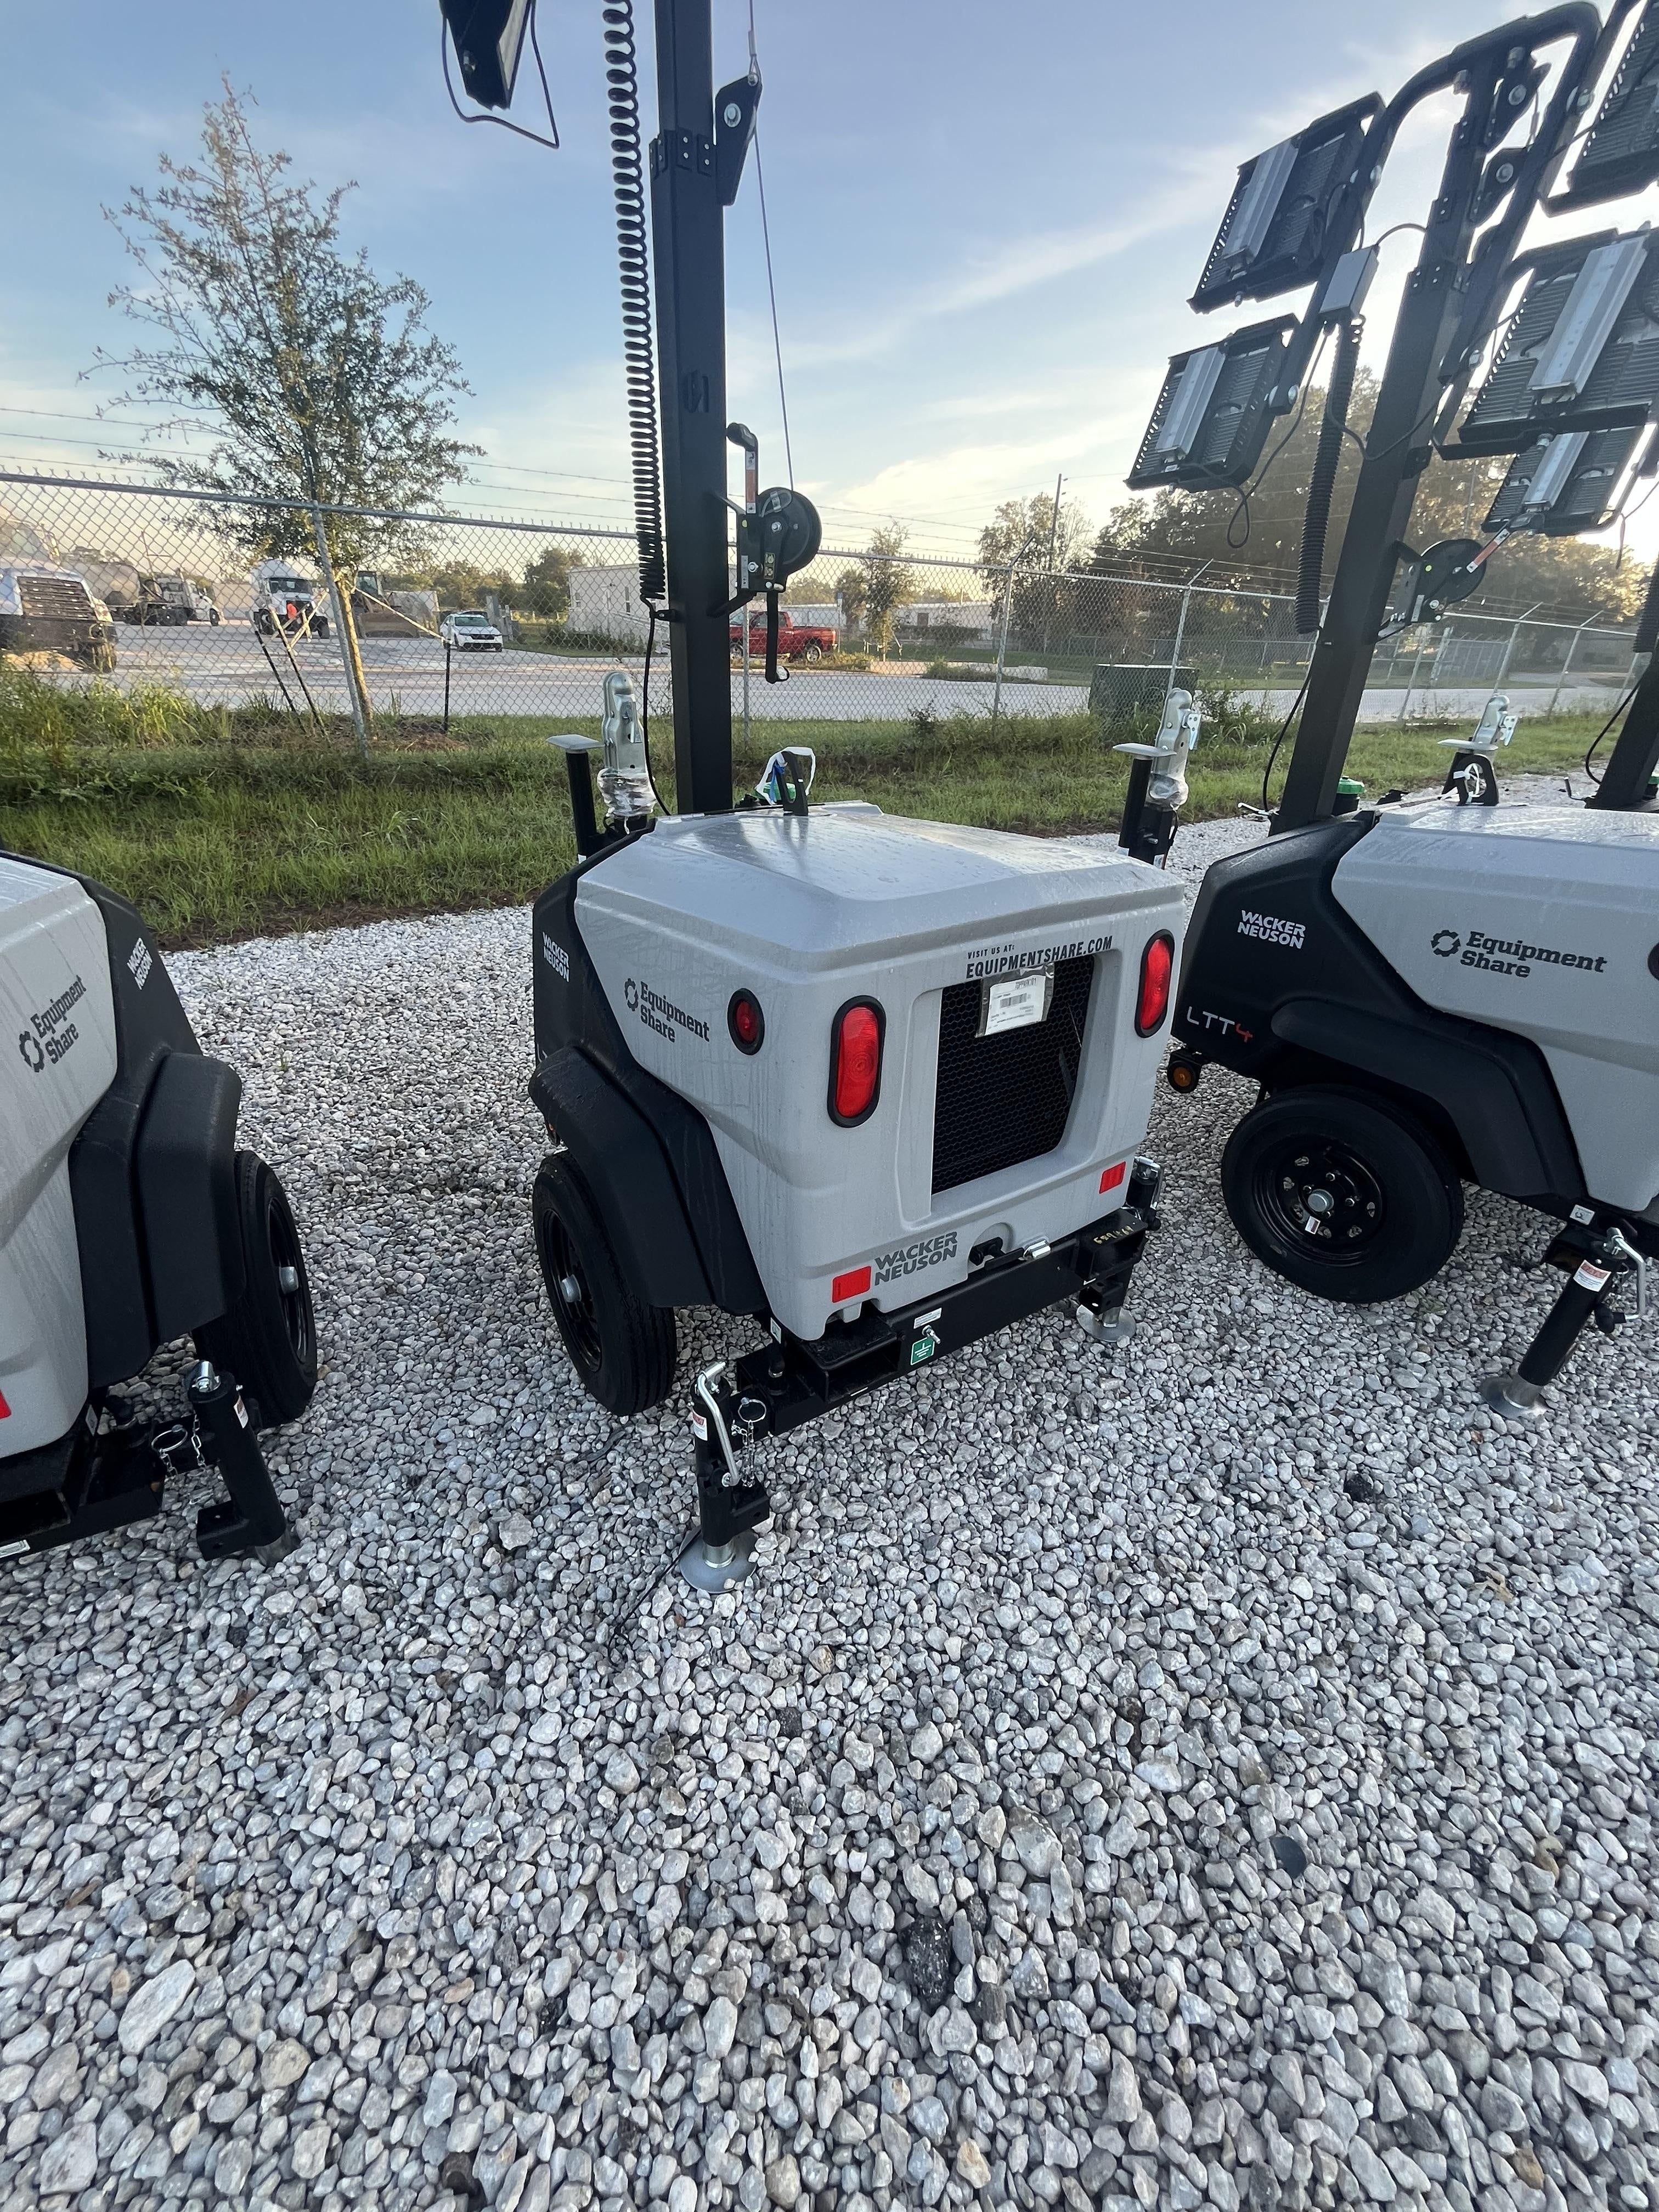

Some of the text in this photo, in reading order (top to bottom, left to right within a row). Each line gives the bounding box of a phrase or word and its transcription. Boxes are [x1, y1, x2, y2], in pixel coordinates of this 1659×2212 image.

[1237, 922, 1305, 950] NEUSON
[1240, 910, 1306, 939] WACKER
[543, 931, 569, 968] WACKER
[543, 946, 569, 983] NEUSON
[966, 935, 1114, 979] EQUIPMENTSHARE.COM
[967, 944, 1015, 959] VISIT US AT:
[1460, 949, 1531, 978] Share
[1466, 930, 1607, 973] Equipment
[30, 974, 87, 1039] Equipment
[640, 980, 710, 1042] Equipment
[640, 1003, 675, 1043] Share
[1187, 1006, 1253, 1043] LTT4
[44, 1022, 79, 1064] Share
[874, 1231, 958, 1270] WACKER
[874, 1244, 957, 1286] NEUSON
